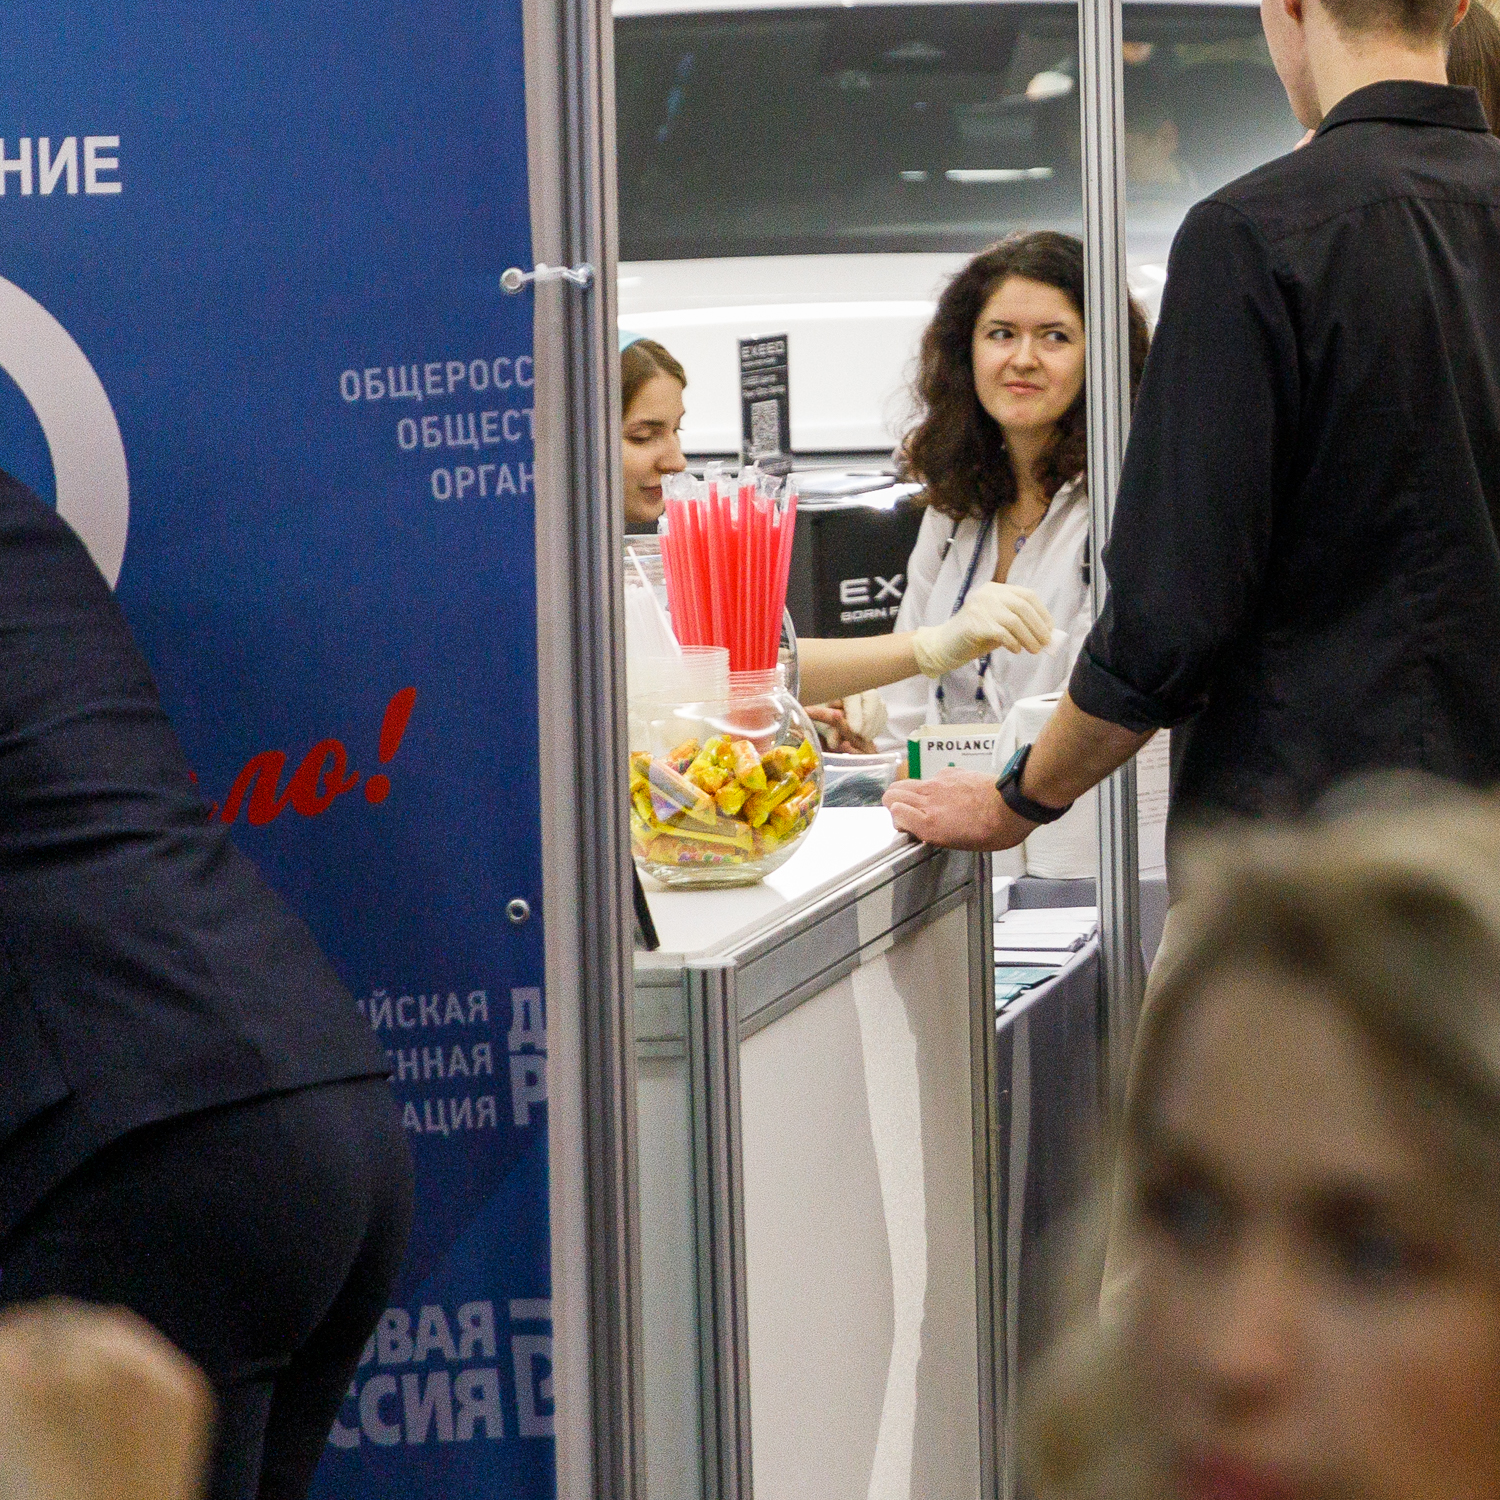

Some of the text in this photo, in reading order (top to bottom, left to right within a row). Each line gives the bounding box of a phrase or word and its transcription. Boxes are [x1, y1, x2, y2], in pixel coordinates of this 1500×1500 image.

[339, 355, 535, 402] ОБЩЕРОСС
[188, 686, 417, 827] ло!
[358, 989, 489, 1031] ЙСКАЯ
[388, 1042, 494, 1083] ННАЯ
